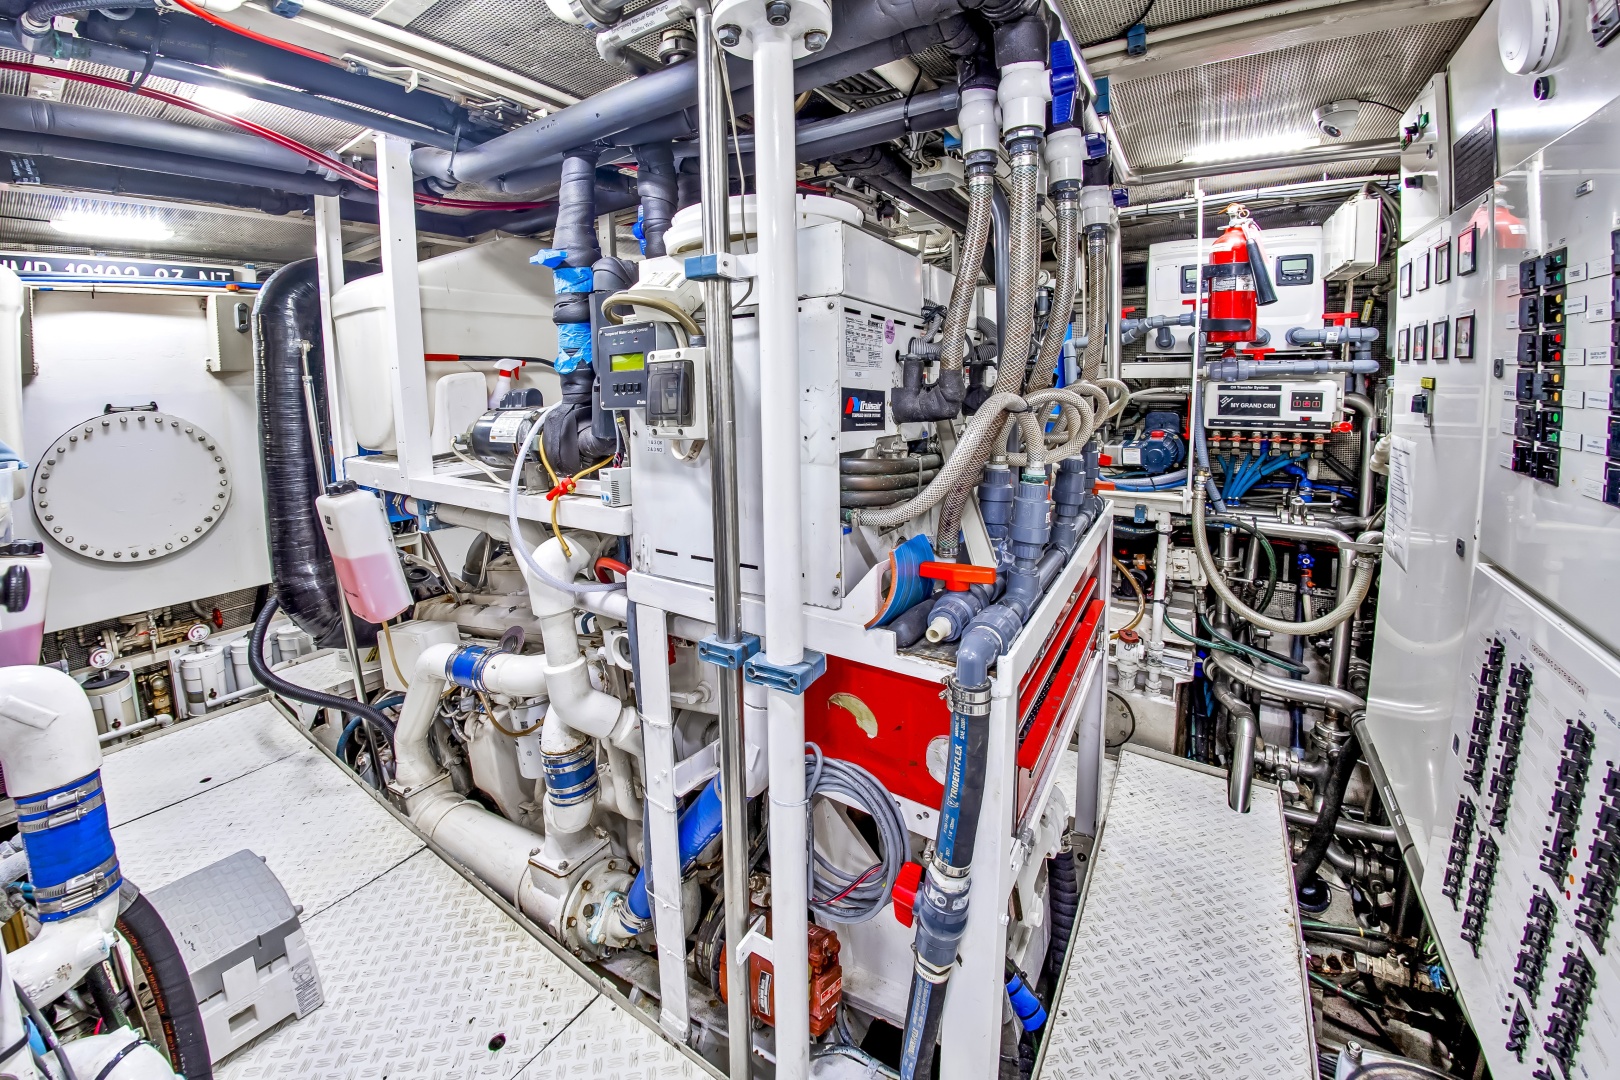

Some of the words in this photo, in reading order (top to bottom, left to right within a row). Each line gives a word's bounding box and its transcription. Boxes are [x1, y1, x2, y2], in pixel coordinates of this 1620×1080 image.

[631, 14, 646, 25] Manual
[645, 8, 657, 19] Bilge
[656, 4, 669, 14] Pump
[1578, 709, 1586, 719] OFF
[1590, 721, 1598, 731] ON
[1604, 708, 1616, 726] PANEL
